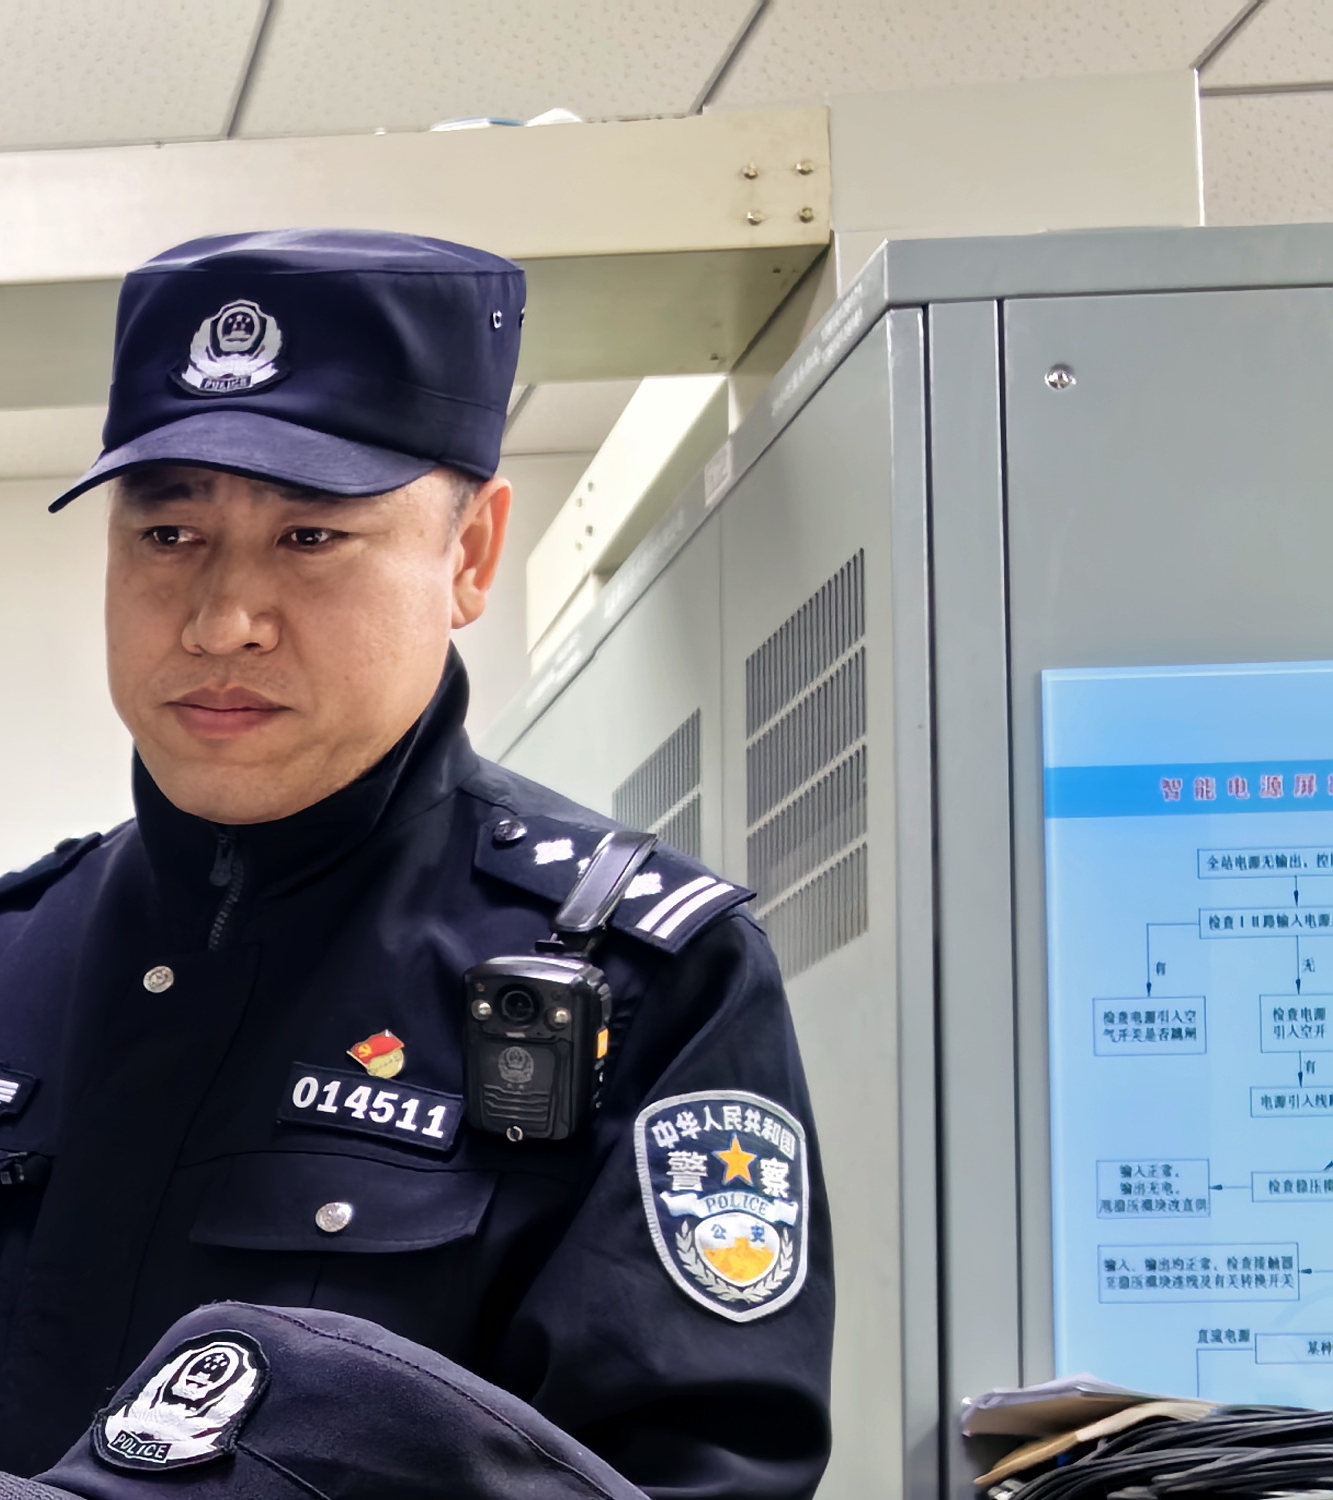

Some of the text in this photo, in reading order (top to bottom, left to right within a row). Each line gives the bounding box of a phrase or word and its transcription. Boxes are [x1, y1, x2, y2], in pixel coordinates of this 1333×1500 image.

[1161, 774, 1333, 802] 智能电源屏
[1273, 1006, 1326, 1023] 检查电源
[292, 1076, 446, 1139] 014511
[651, 1105, 796, 1161] 中华人民共和国
[666, 1151, 790, 1198] 警察
[706, 1194, 768, 1217] POLICE
[710, 1223, 766, 1243] 公安
[114, 1433, 168, 1459] POLICE
